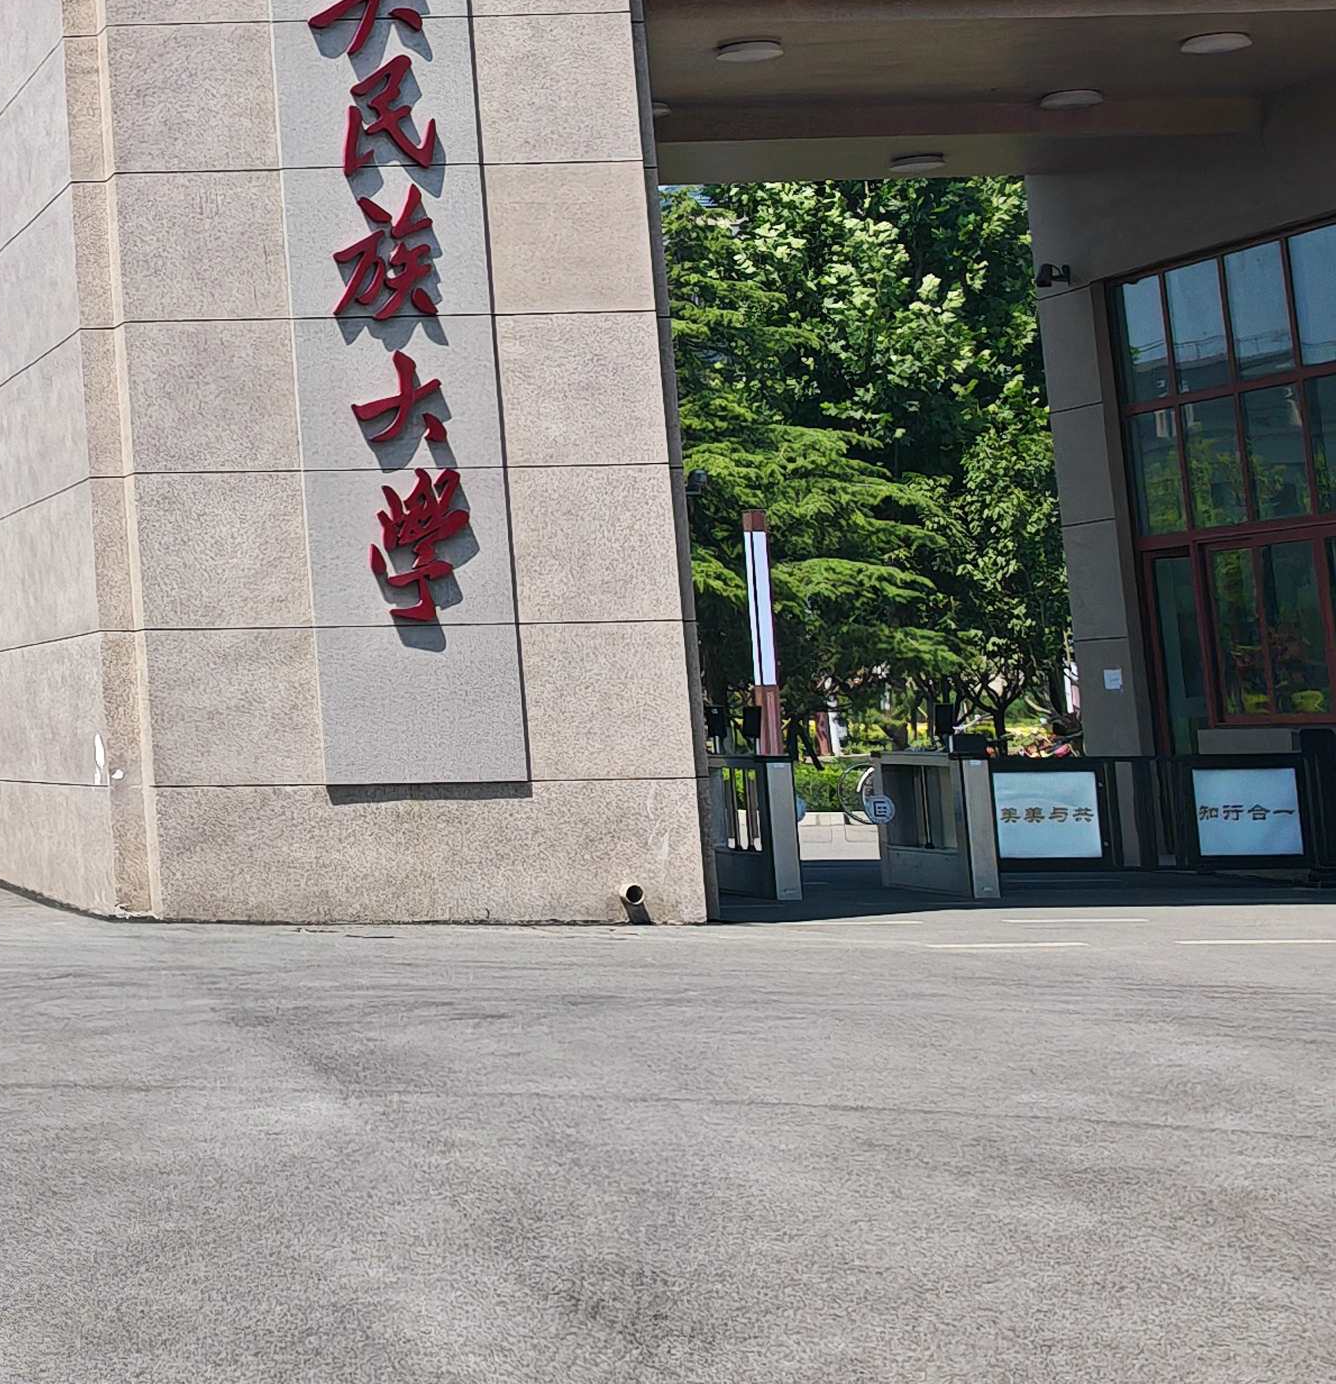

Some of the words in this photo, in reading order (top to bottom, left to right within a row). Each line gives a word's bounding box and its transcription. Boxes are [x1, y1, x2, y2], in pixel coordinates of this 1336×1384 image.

[1000, 806, 1094, 824] 美美与共
[1198, 804, 1295, 821] 知行合一
